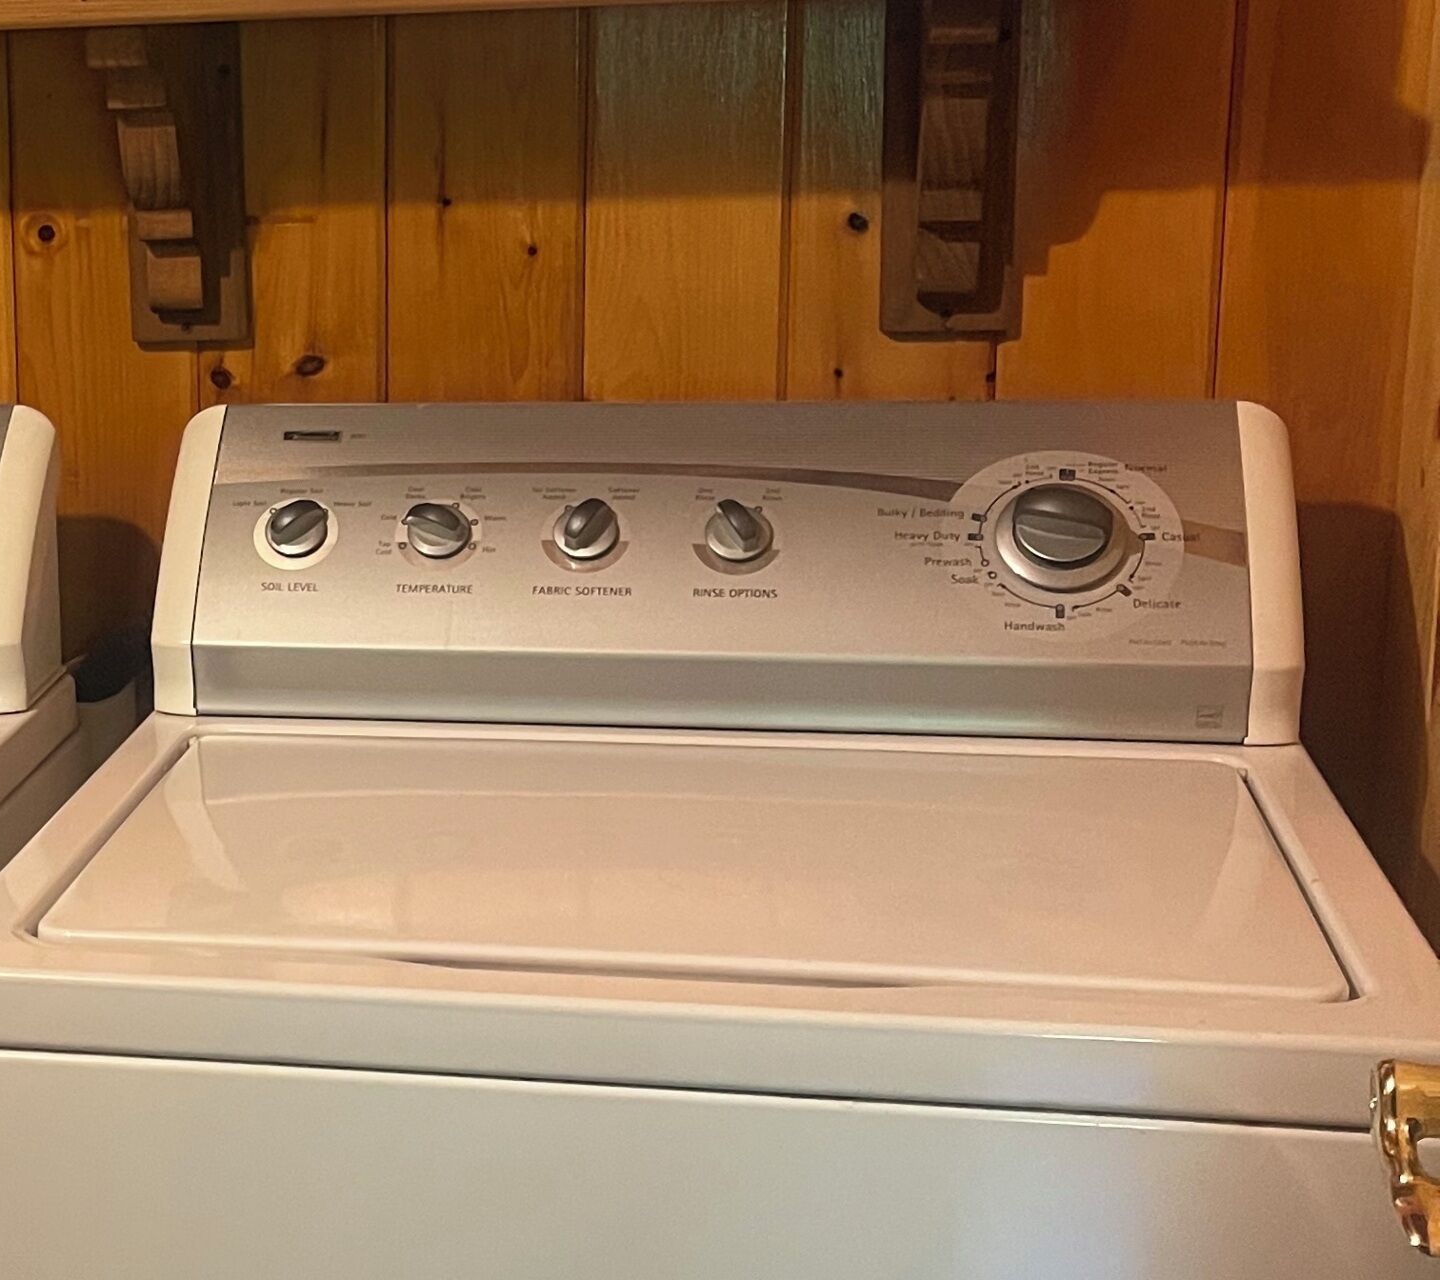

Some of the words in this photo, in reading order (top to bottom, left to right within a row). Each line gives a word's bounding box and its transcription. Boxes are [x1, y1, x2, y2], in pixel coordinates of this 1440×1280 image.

[877, 508, 907, 518] Bulky
[919, 508, 965, 519] Bedding
[894, 531, 929, 541] Heavy
[933, 531, 961, 541] Duty
[1162, 532, 1200, 541] Casual
[924, 557, 972, 566] Prewash
[951, 574, 979, 585] Soak
[260, 582, 283, 591] SOIL
[288, 582, 318, 592] LEVEL
[396, 584, 473, 594] TEMPERATURE
[532, 586, 571, 595] FABRIC
[575, 586, 632, 597] SOFTENER
[693, 588, 725, 598] RINSE
[729, 588, 778, 599] OPTIONS
[1133, 598, 1181, 609] Delicate
[1004, 622, 1065, 631] Handwash
